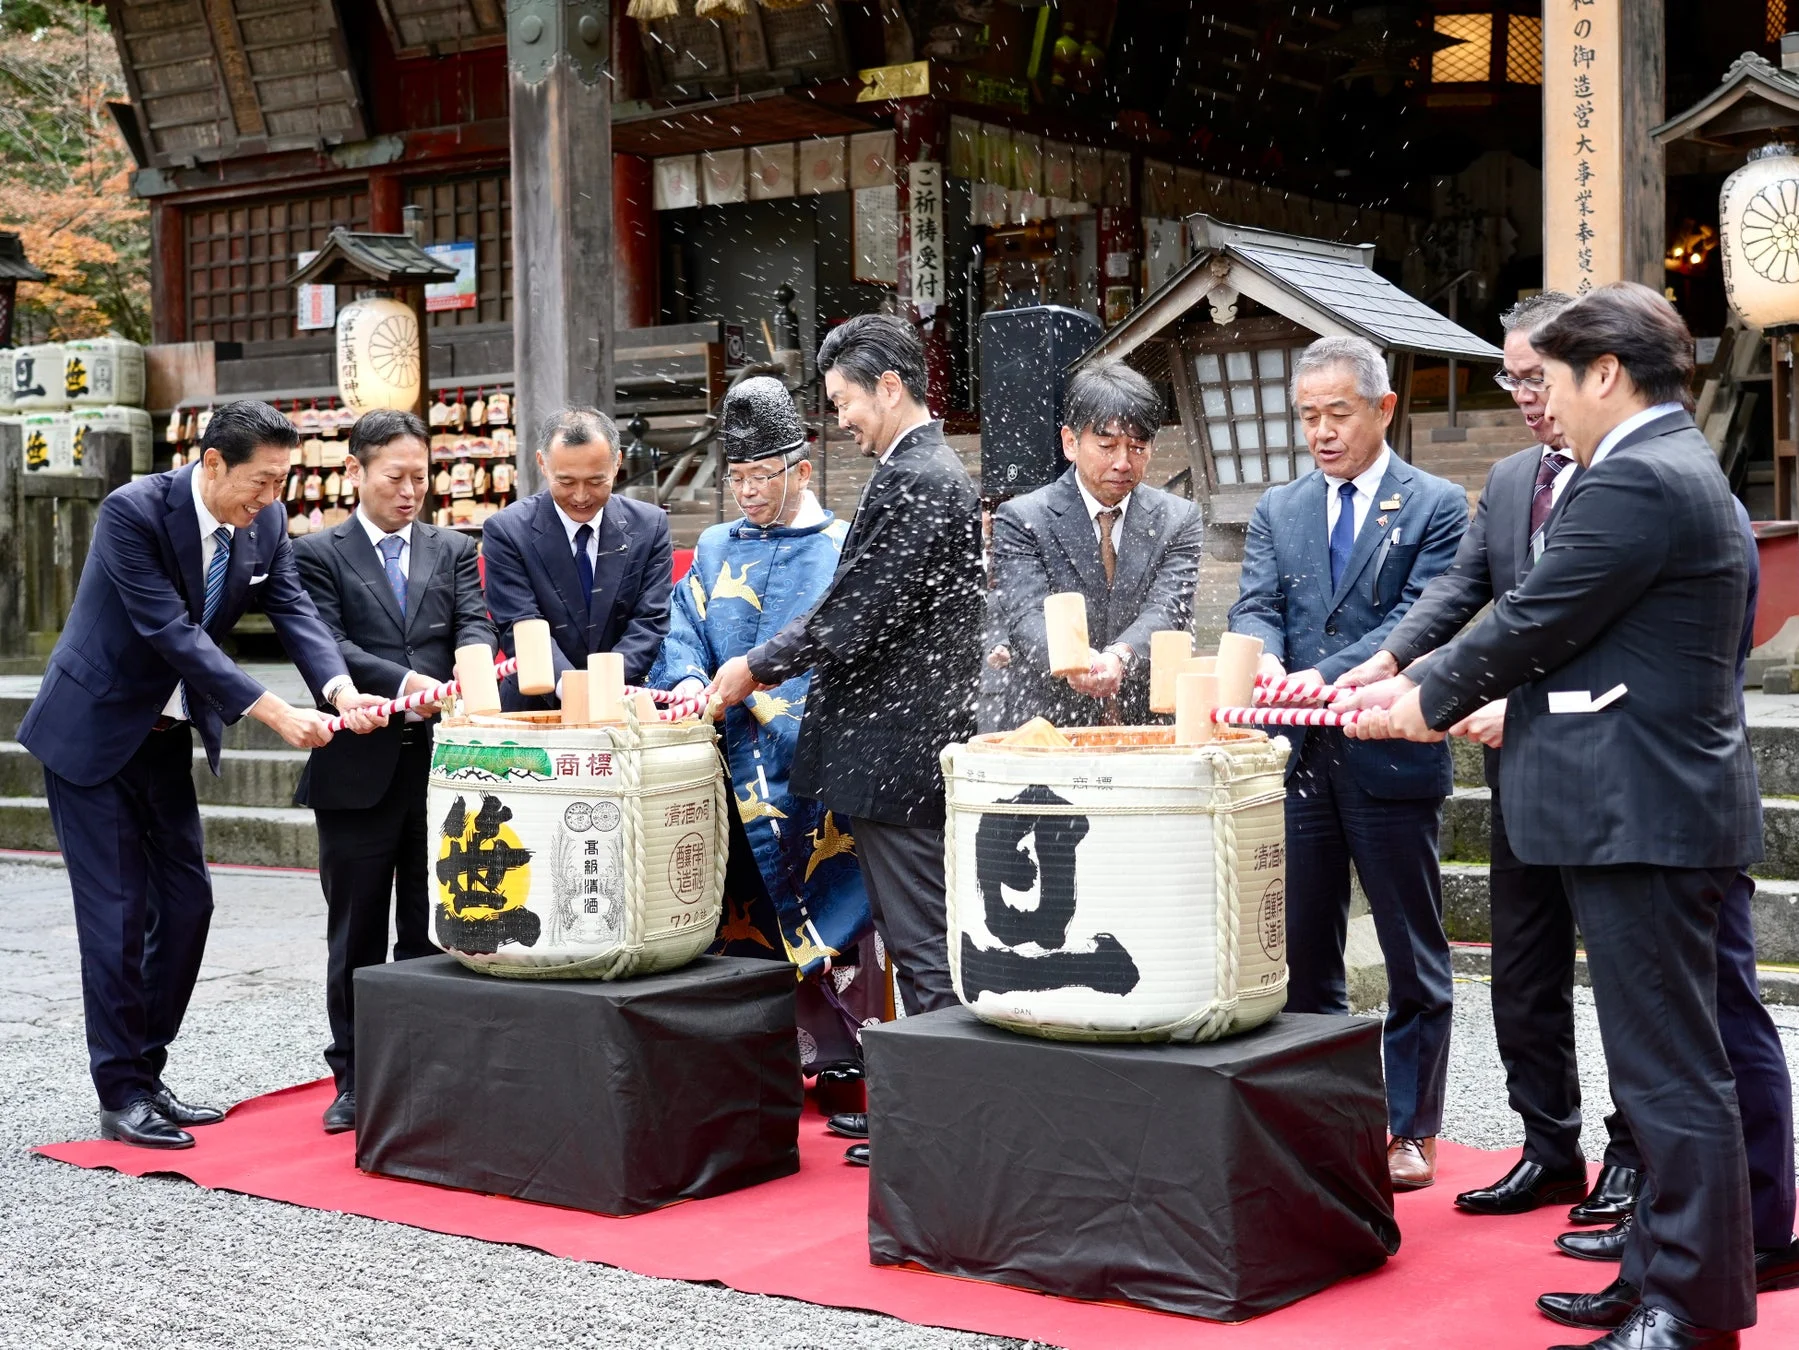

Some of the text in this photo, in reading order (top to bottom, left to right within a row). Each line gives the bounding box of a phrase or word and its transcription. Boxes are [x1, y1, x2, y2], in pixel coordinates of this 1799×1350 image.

[913, 166, 940, 298] ご祈祷受付
[555, 752, 613, 777] 商標
[1013, 1007, 1032, 1016] DAN
